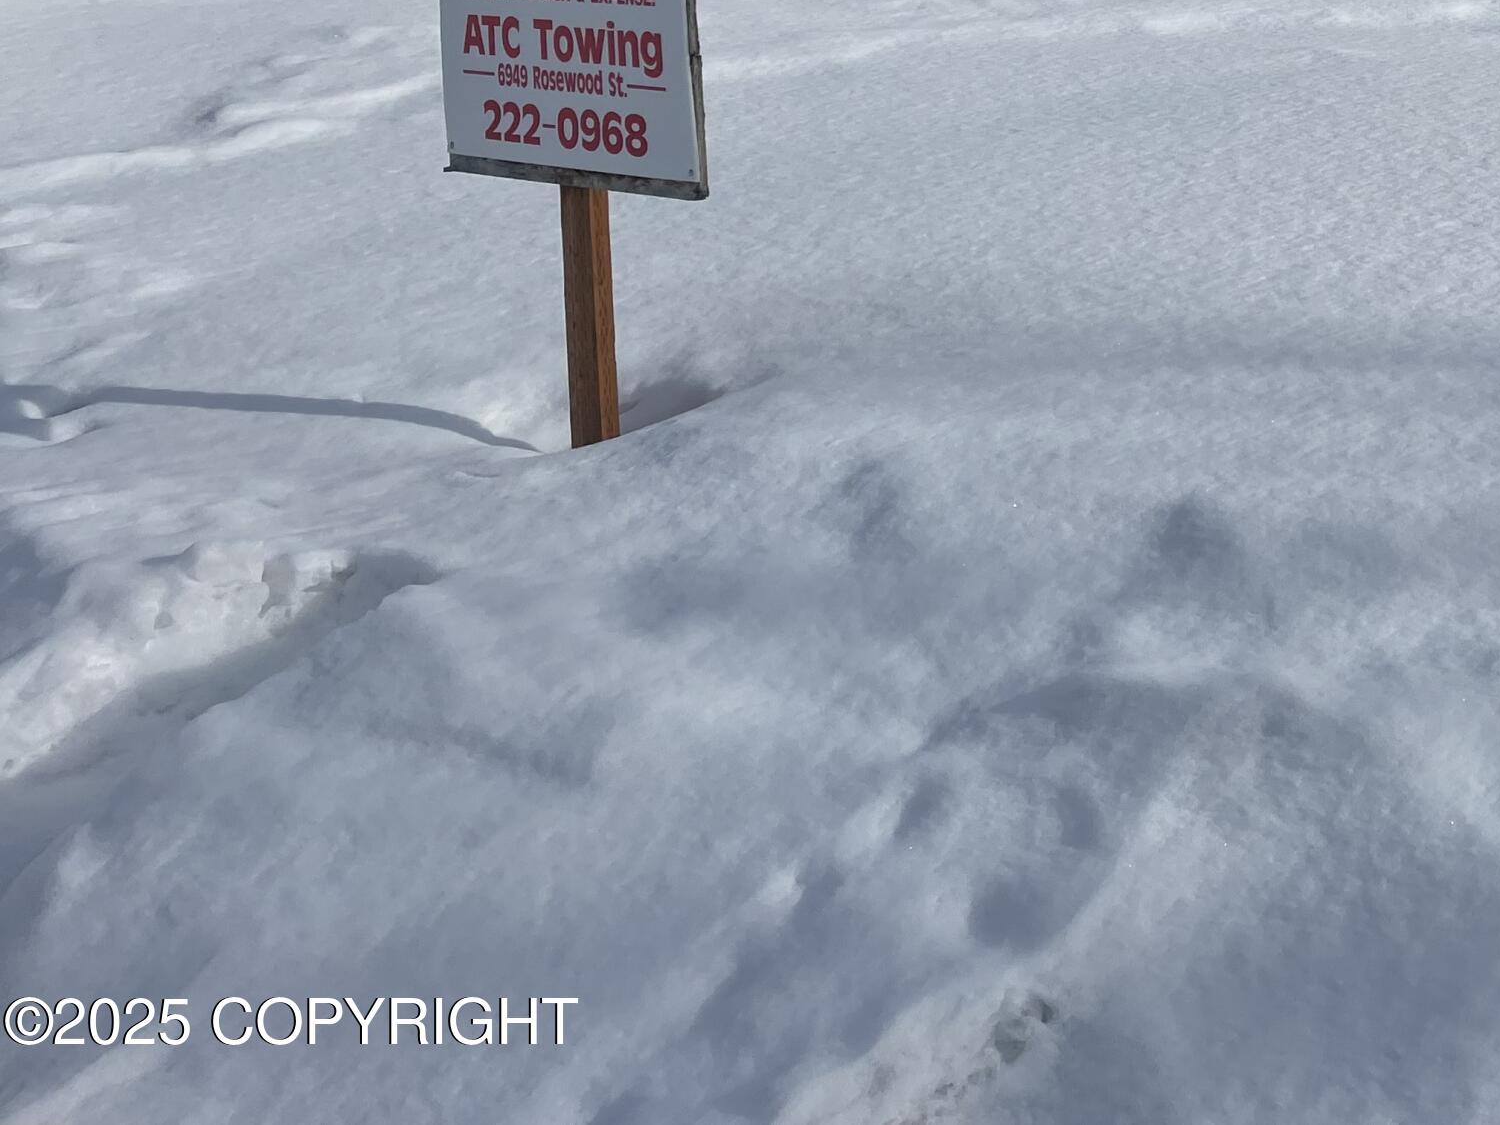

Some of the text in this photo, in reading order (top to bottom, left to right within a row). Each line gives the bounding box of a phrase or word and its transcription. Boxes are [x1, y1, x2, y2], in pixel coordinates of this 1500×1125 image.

[463, 14, 664, 78] ATC Towing
[498, 63, 628, 98] 6949 Rosewood St.
[483, 99, 649, 158] 222-0968
